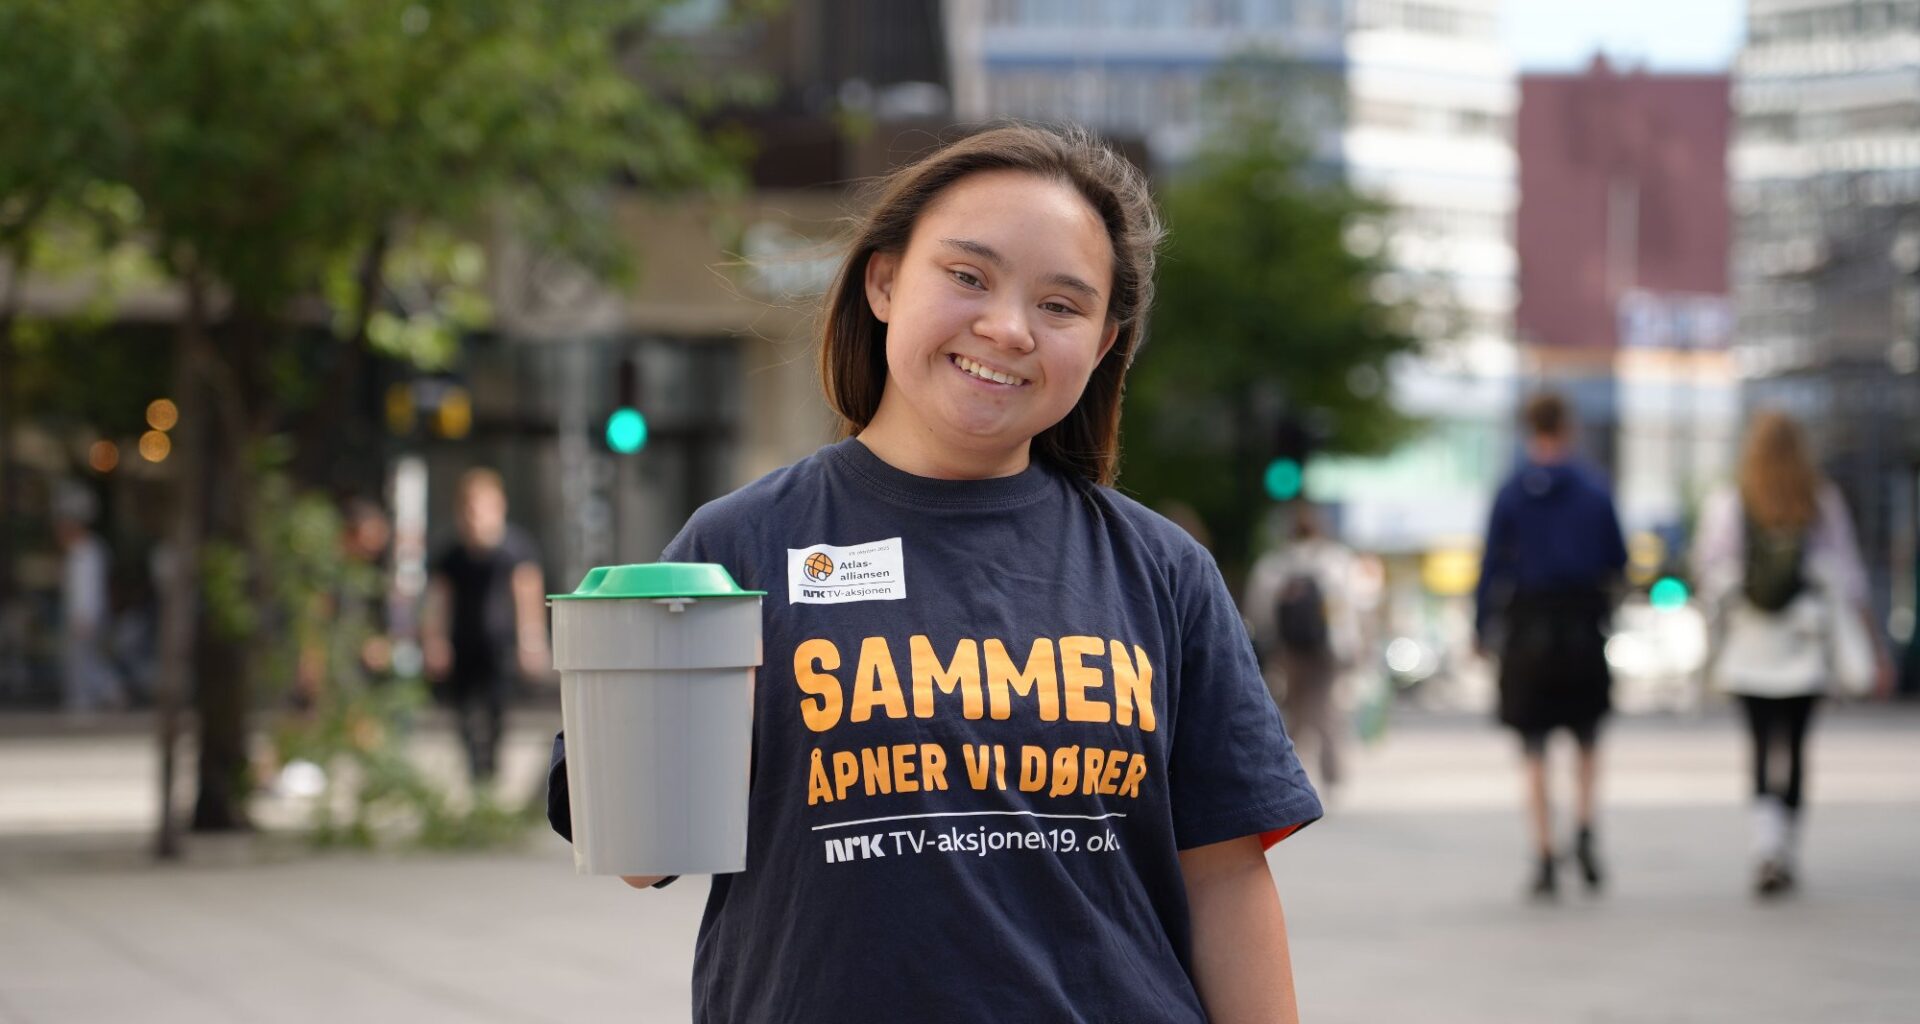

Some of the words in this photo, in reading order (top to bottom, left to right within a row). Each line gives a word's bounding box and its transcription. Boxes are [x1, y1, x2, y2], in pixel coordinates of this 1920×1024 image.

[839, 560, 872, 570] Atlas-
[840, 569, 890, 581] alliansen
[828, 587, 891, 597] TV-aksjonen
[793, 634, 1156, 732] SAMMEN
[807, 743, 948, 806] ÅPNER
[963, 744, 1007, 790] VI
[1018, 744, 1147, 798] DØRER
[1049, 828, 1080, 852] 19.
